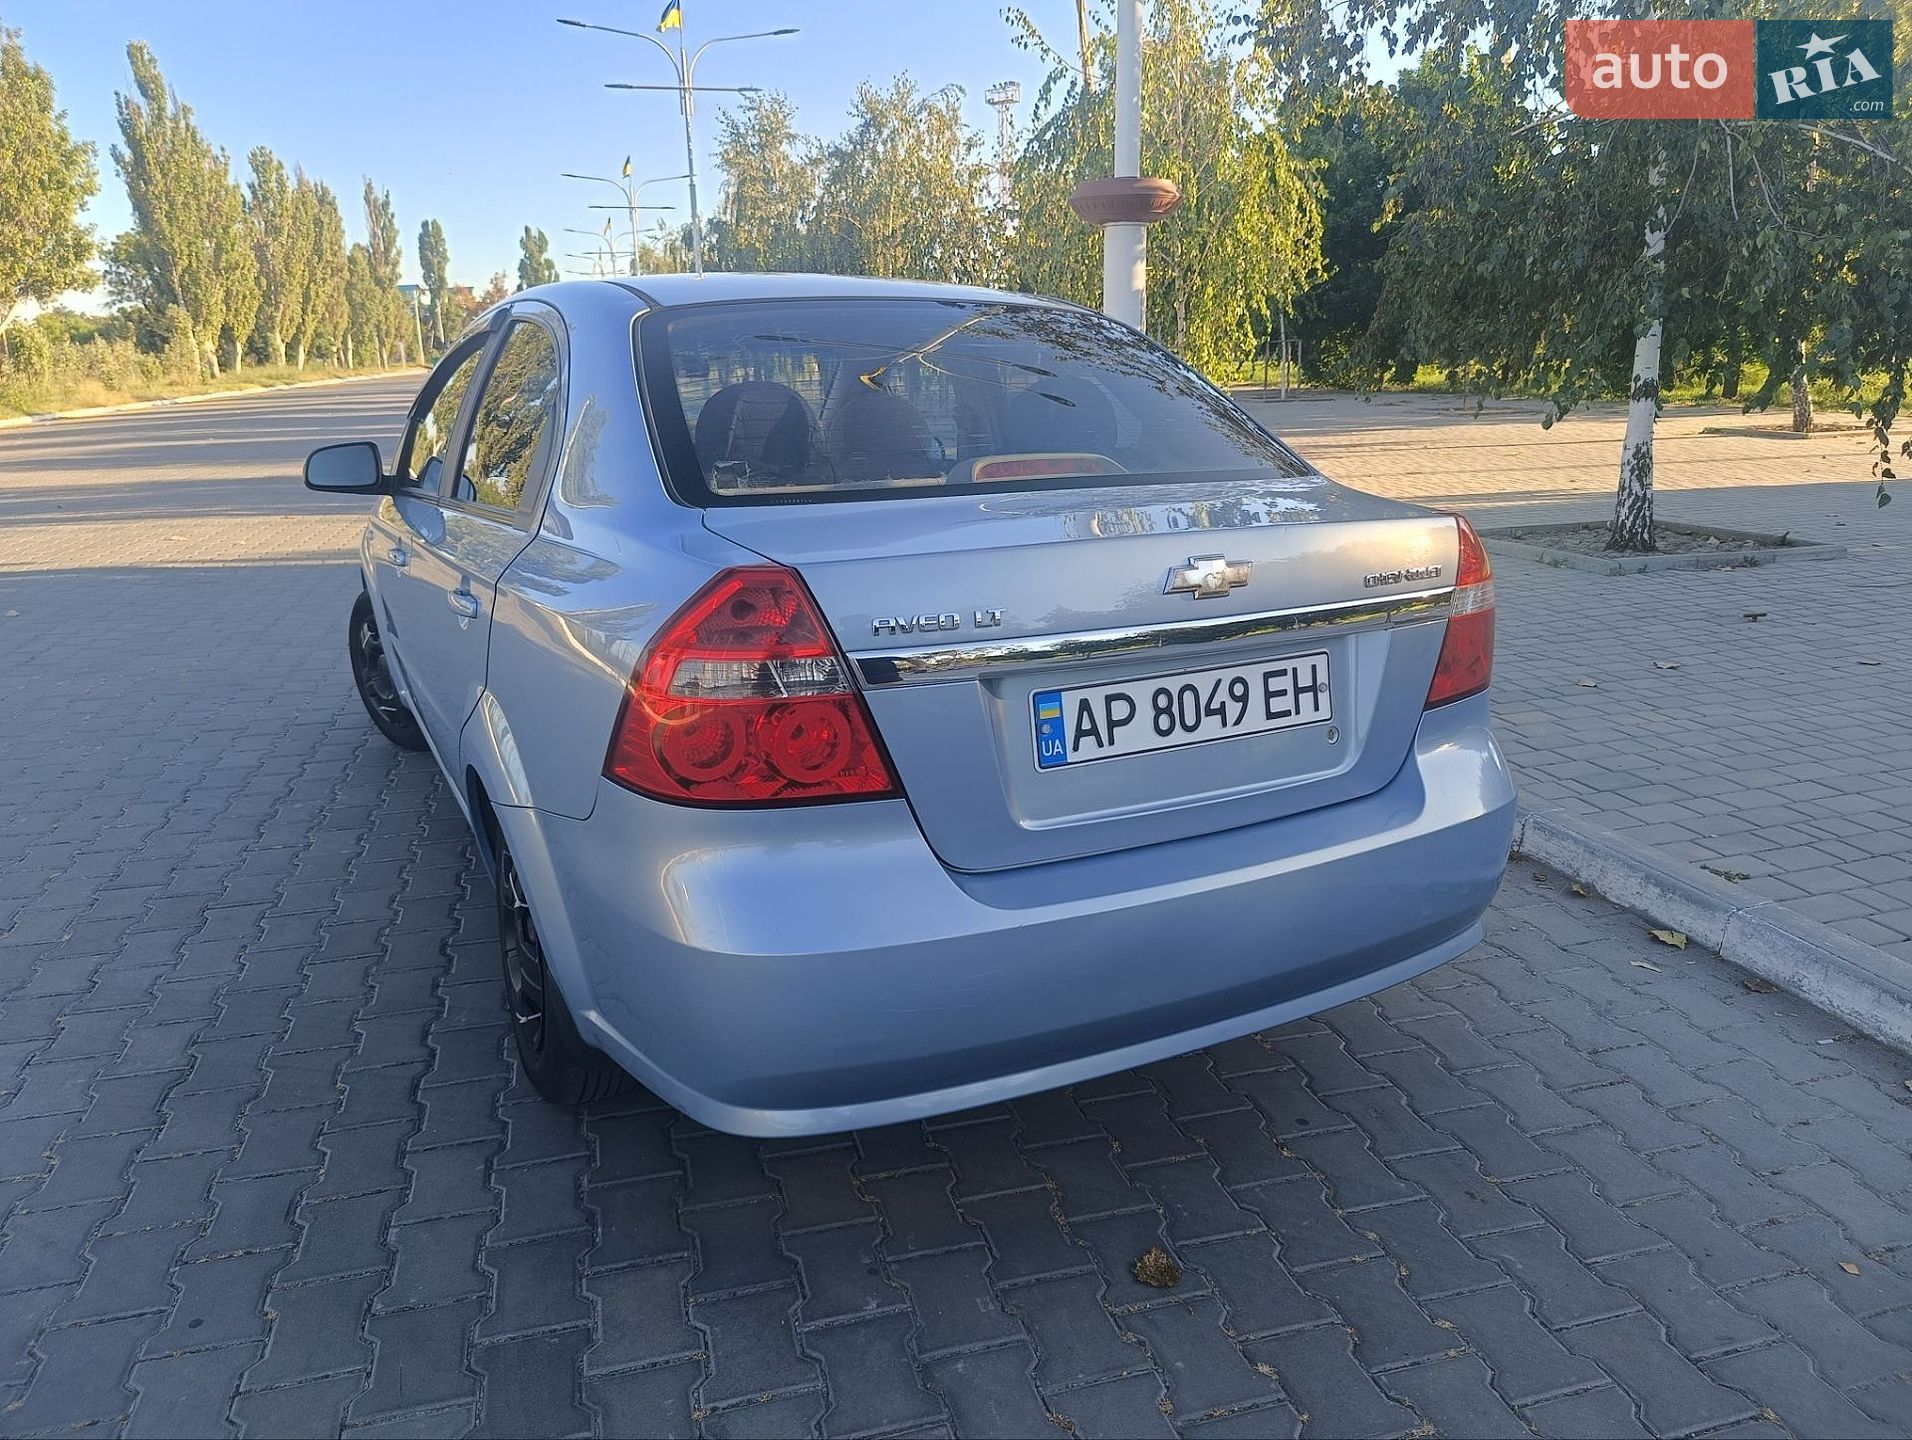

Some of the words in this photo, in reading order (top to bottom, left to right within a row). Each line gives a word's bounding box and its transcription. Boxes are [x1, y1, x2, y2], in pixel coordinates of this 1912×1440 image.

[872, 612, 961, 636] AVEO
[974, 607, 1007, 628] LT
[1072, 692, 1136, 752] AP
[1152, 676, 1250, 737] 8049
[1263, 664, 1320, 720] EH
[1042, 738, 1063, 757] UA
